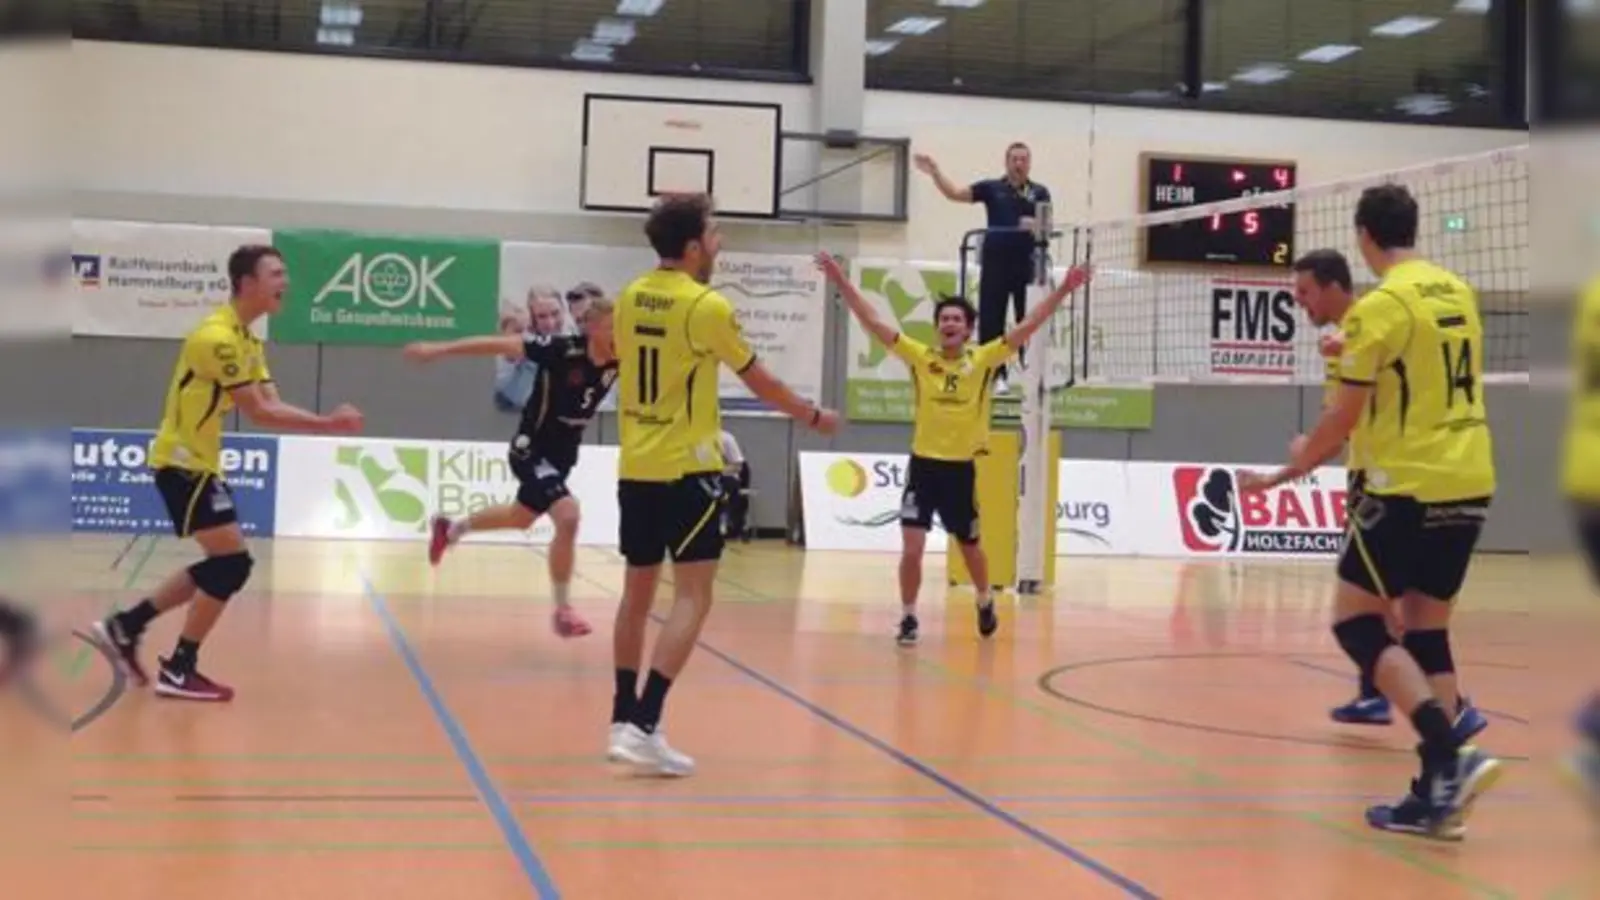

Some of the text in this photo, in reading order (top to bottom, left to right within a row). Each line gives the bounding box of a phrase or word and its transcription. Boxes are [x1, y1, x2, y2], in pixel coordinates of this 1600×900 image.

[1274, 168, 1288, 187] 4
[1156, 185, 1195, 203] HEIM
[1244, 211, 1259, 235] 5
[108, 256, 218, 273] Raiffeisenbank
[1273, 243, 1289, 264] 2
[108, 276, 204, 295] Hammelburg
[312, 252, 457, 310] AOK
[310, 308, 333, 323] Die
[1211, 288, 1296, 343] FMS
[638, 345, 660, 404] 11
[944, 374, 960, 393] 15
[1442, 338, 1475, 410] 14
[580, 387, 595, 410] 5
[438, 448, 515, 482] Klin
[873, 461, 906, 488] St
